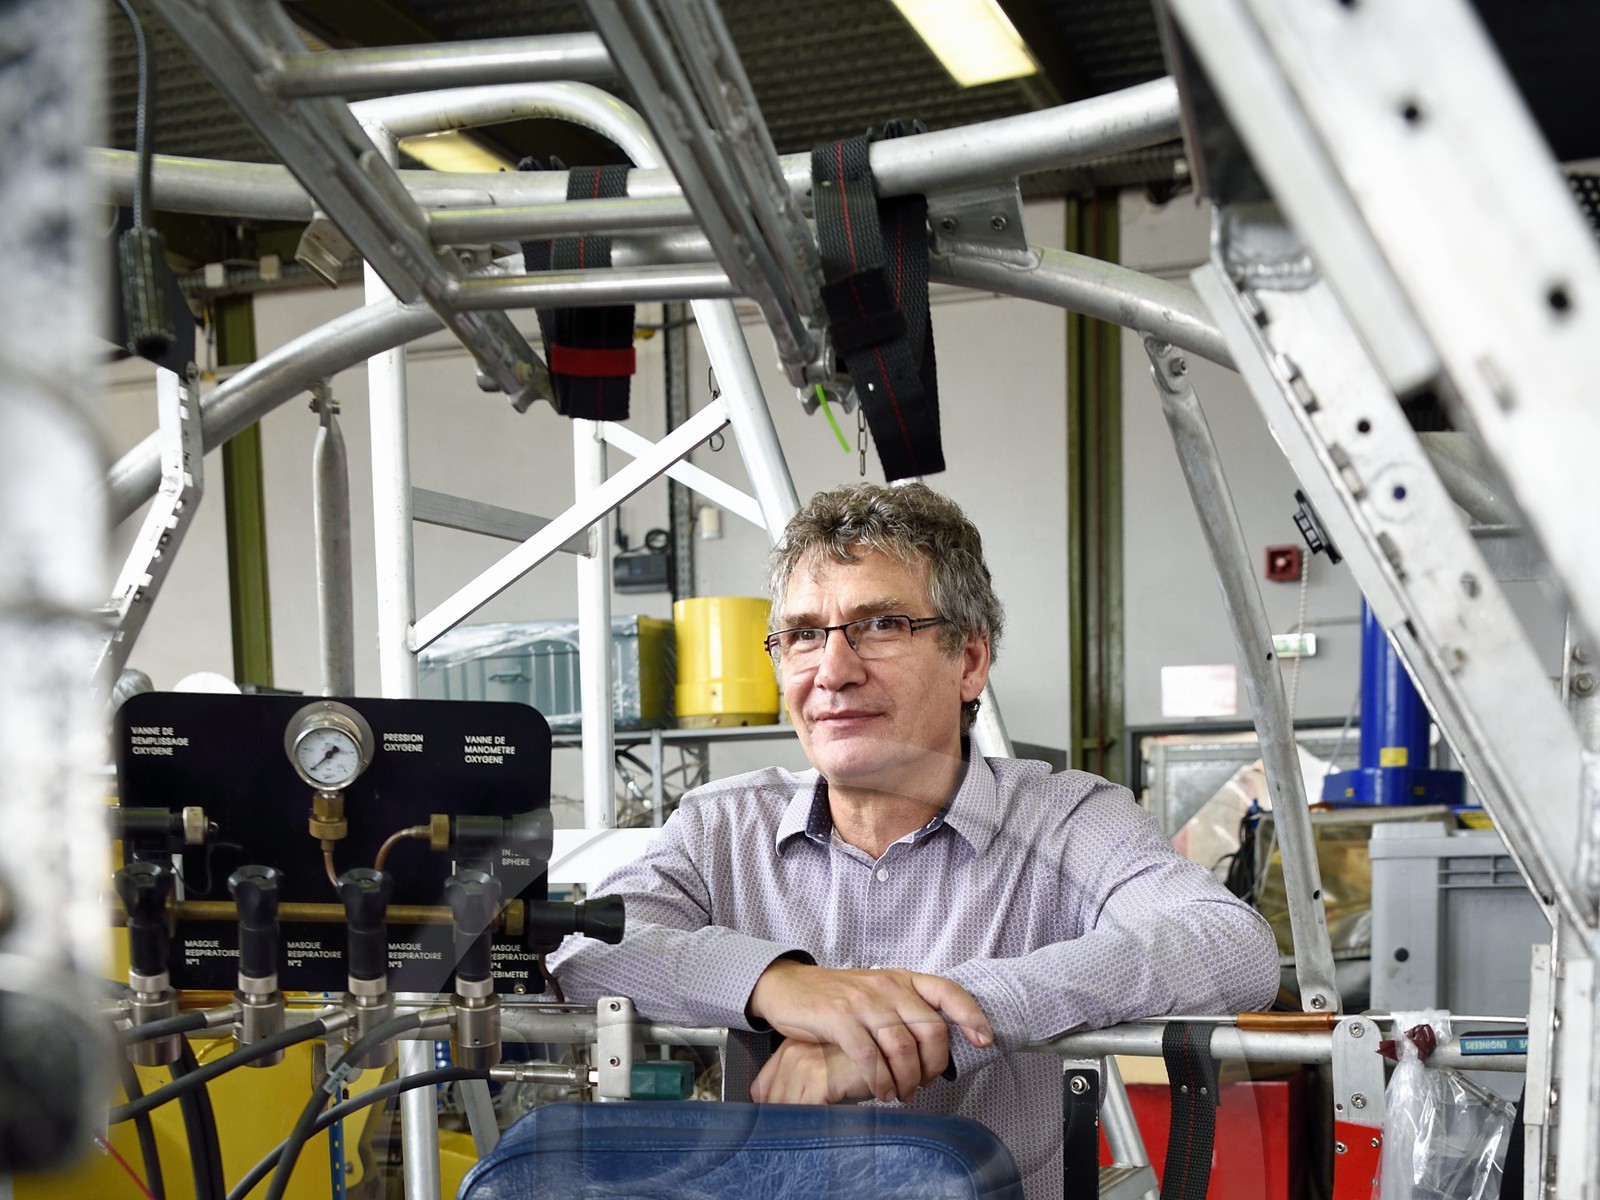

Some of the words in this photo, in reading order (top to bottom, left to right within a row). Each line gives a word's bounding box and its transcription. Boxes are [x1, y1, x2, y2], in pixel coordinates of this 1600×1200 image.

[131, 726, 160, 736] VANNE
[162, 727, 174, 736] DE
[131, 736, 189, 746] REMPLISSAGE
[383, 733, 424, 743] PRESSION
[465, 735, 493, 745] VANNE
[494, 736, 506, 745] DE
[132, 746, 173, 756] OXYGENE
[383, 743, 424, 753] OXYGENE
[465, 745, 516, 755] MANOMETRE
[465, 755, 504, 764] OXYGENE
[501, 857, 531, 866] SPHERE
[184, 940, 220, 948] MASQUE
[287, 941, 321, 949] MASQUE
[388, 943, 422, 951] MASQUE
[185, 949, 241, 957] RESPIRATOIRE
[287, 950, 342, 959] RESPIRATOIRE
[388, 951, 442, 960] RESPIRATOIRE
[287, 959, 303, 967] N°2
[1464, 1039, 1507, 1050] ENGINEERS
